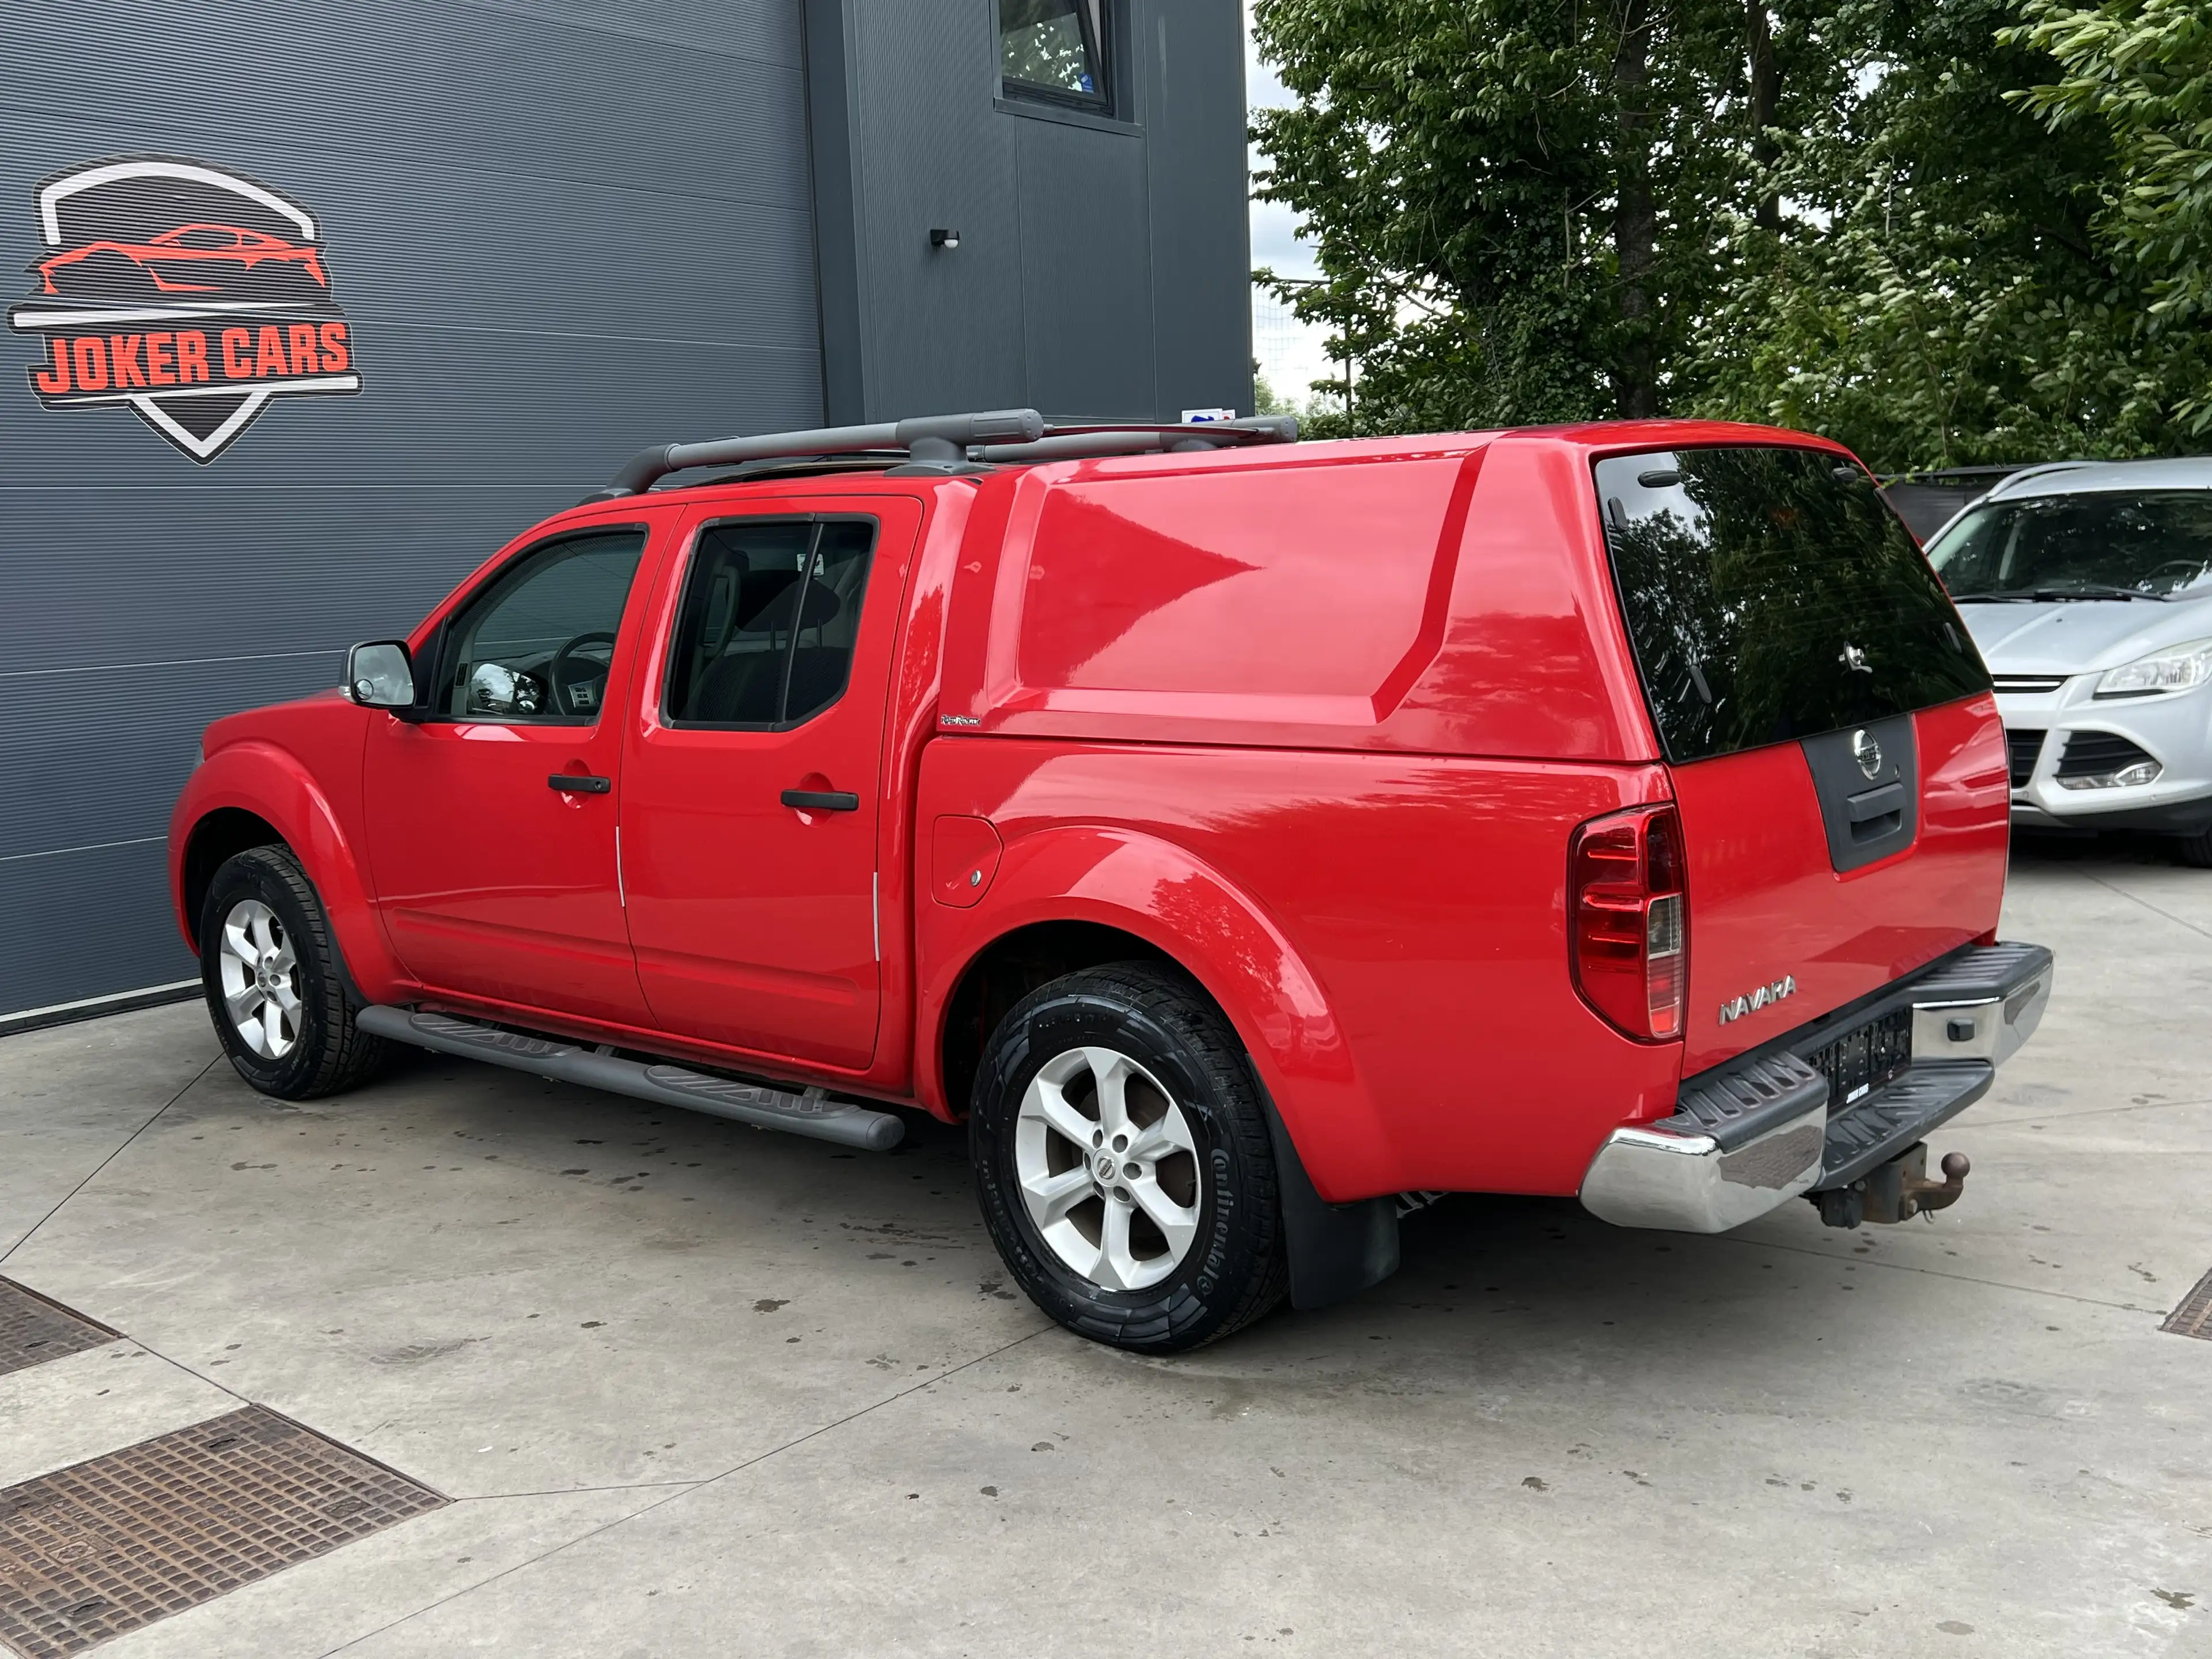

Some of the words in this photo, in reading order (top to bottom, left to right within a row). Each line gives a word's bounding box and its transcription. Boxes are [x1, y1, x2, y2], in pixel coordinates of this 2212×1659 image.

[37, 331, 209, 393] JOKER
[221, 323, 348, 378] CARS
[1718, 975, 1796, 1025] NAVARA
[1203, 1149, 1234, 1279] Continental
